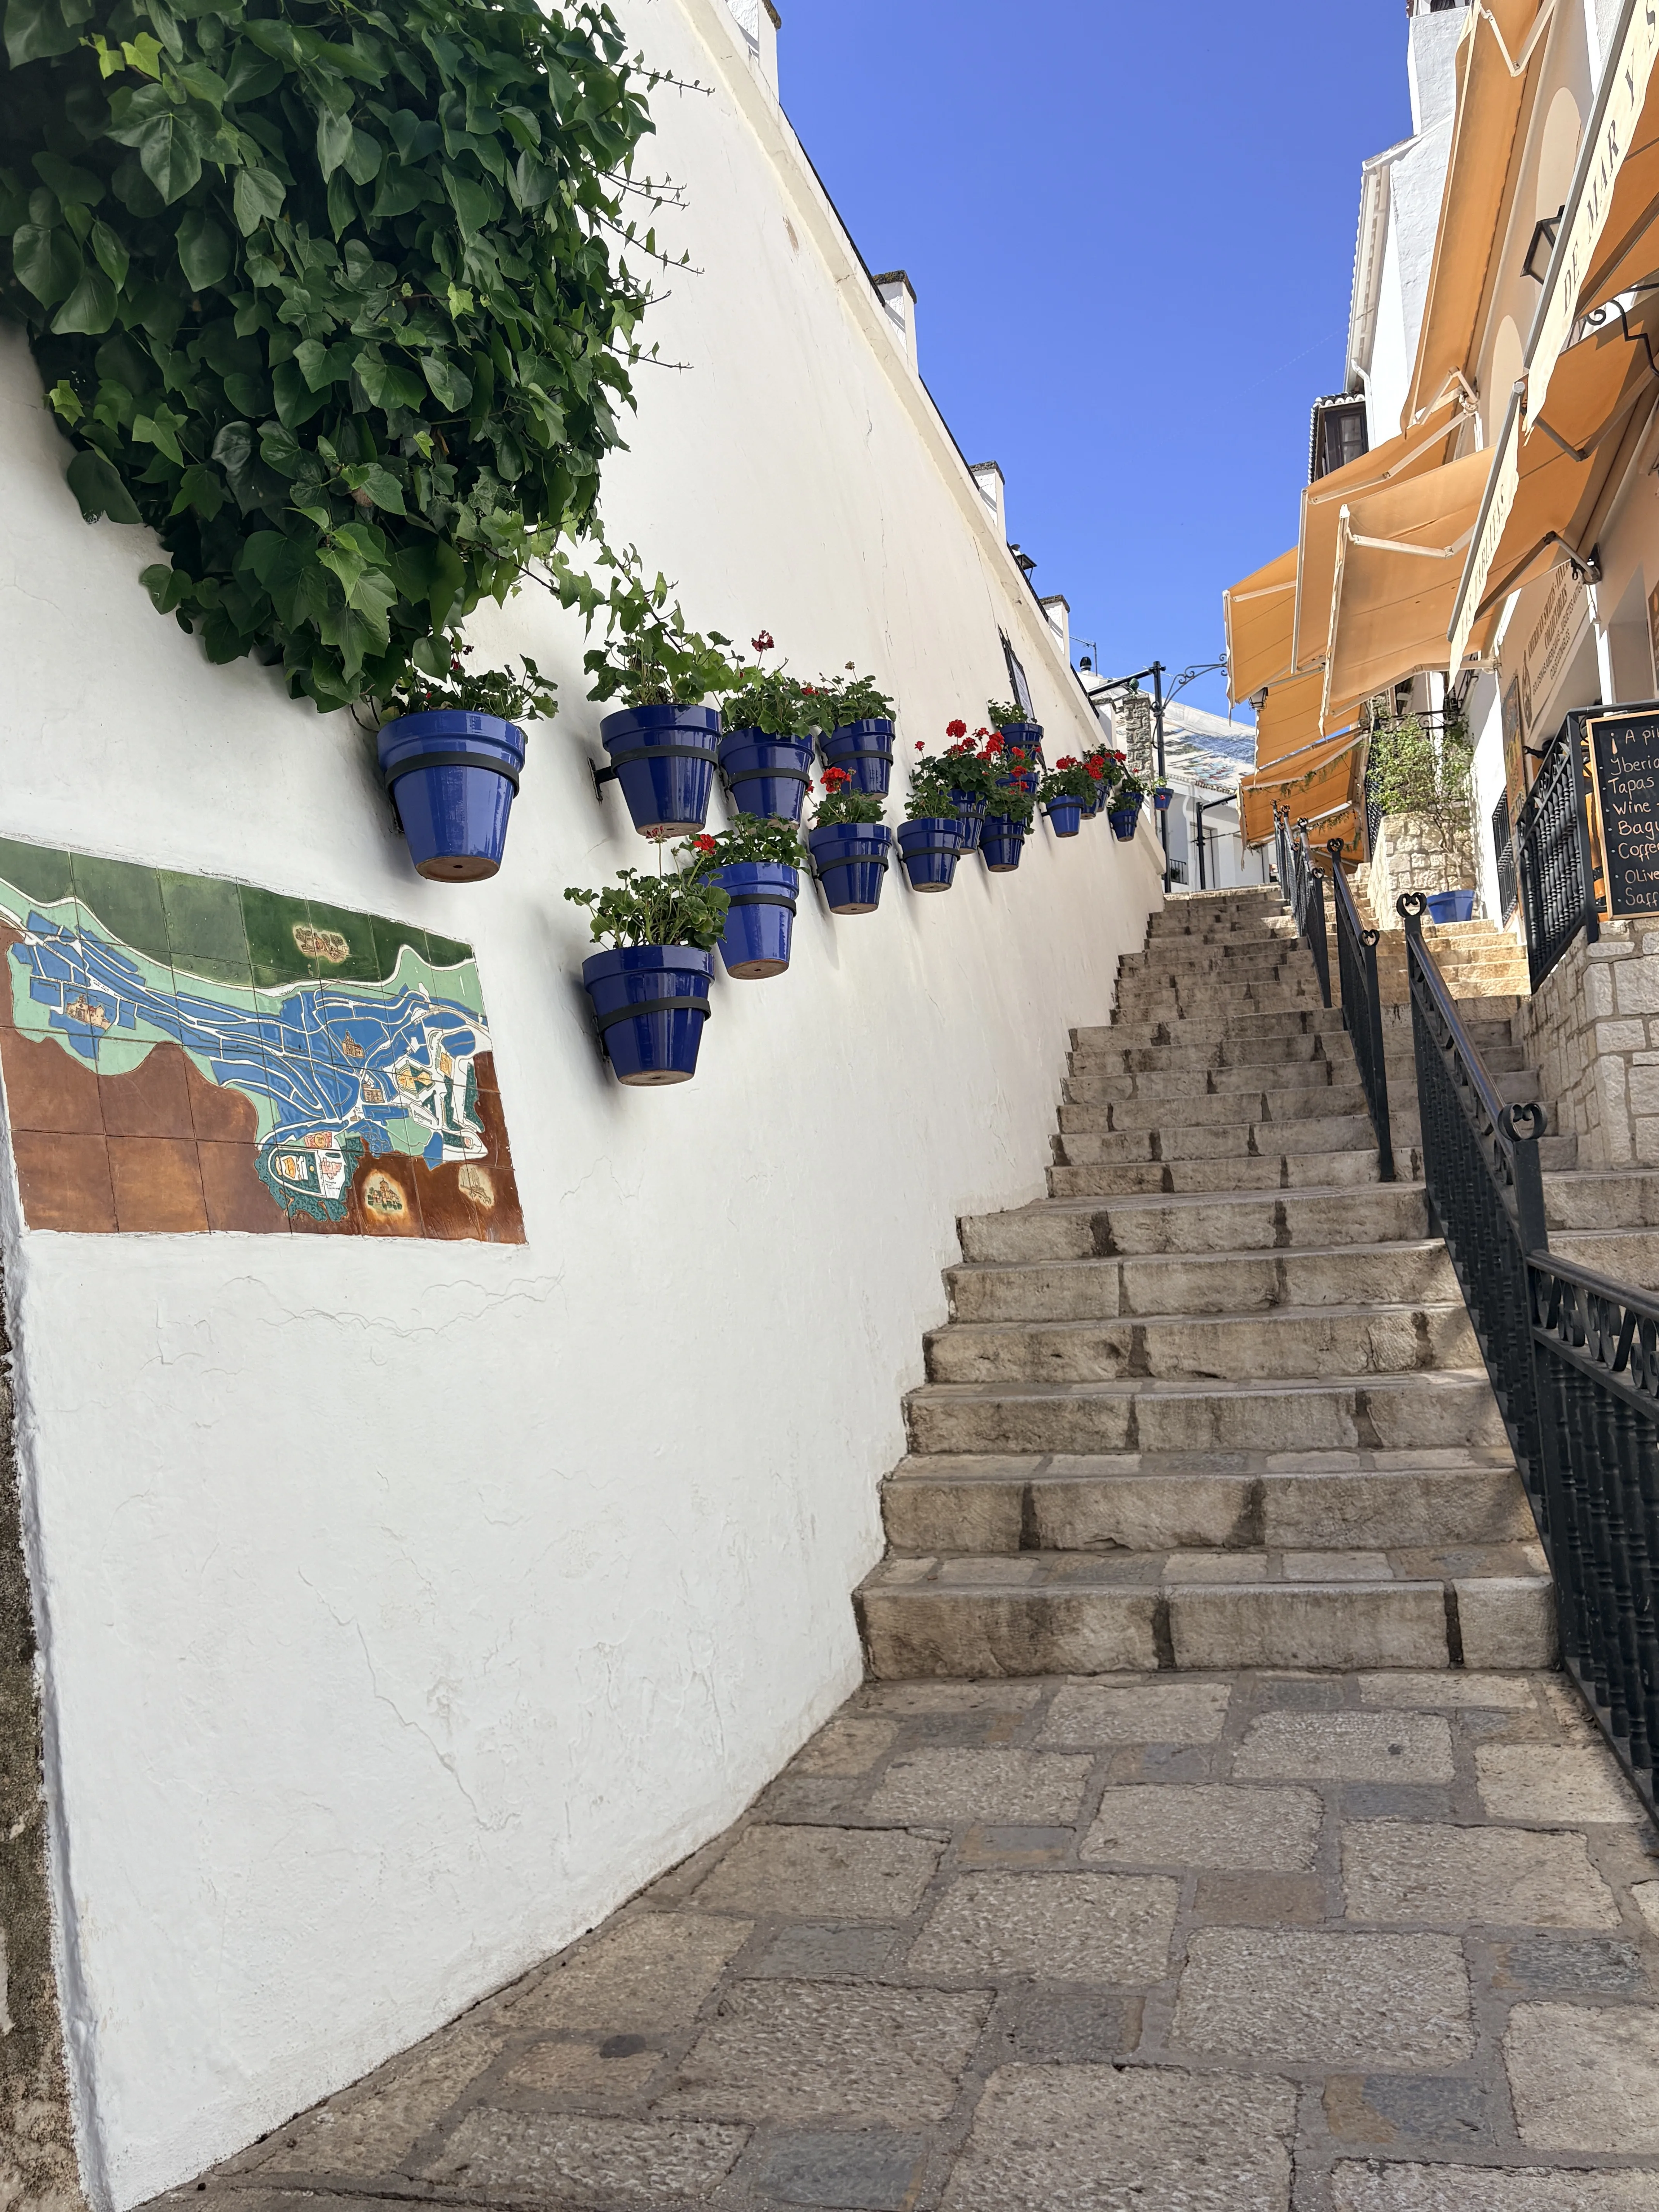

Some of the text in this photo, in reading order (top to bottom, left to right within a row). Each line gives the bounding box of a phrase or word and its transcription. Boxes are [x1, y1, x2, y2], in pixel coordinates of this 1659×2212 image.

[1563, 239, 1579, 318] DE
[1587, 119, 1619, 246] MAR
[1625, 48, 1634, 112] Y
[1475, 484, 1504, 599] TABLITAS
[1625, 729, 1636, 744] A
[1607, 776, 1655, 800] Tapas
[1613, 801, 1651, 815] Wine
